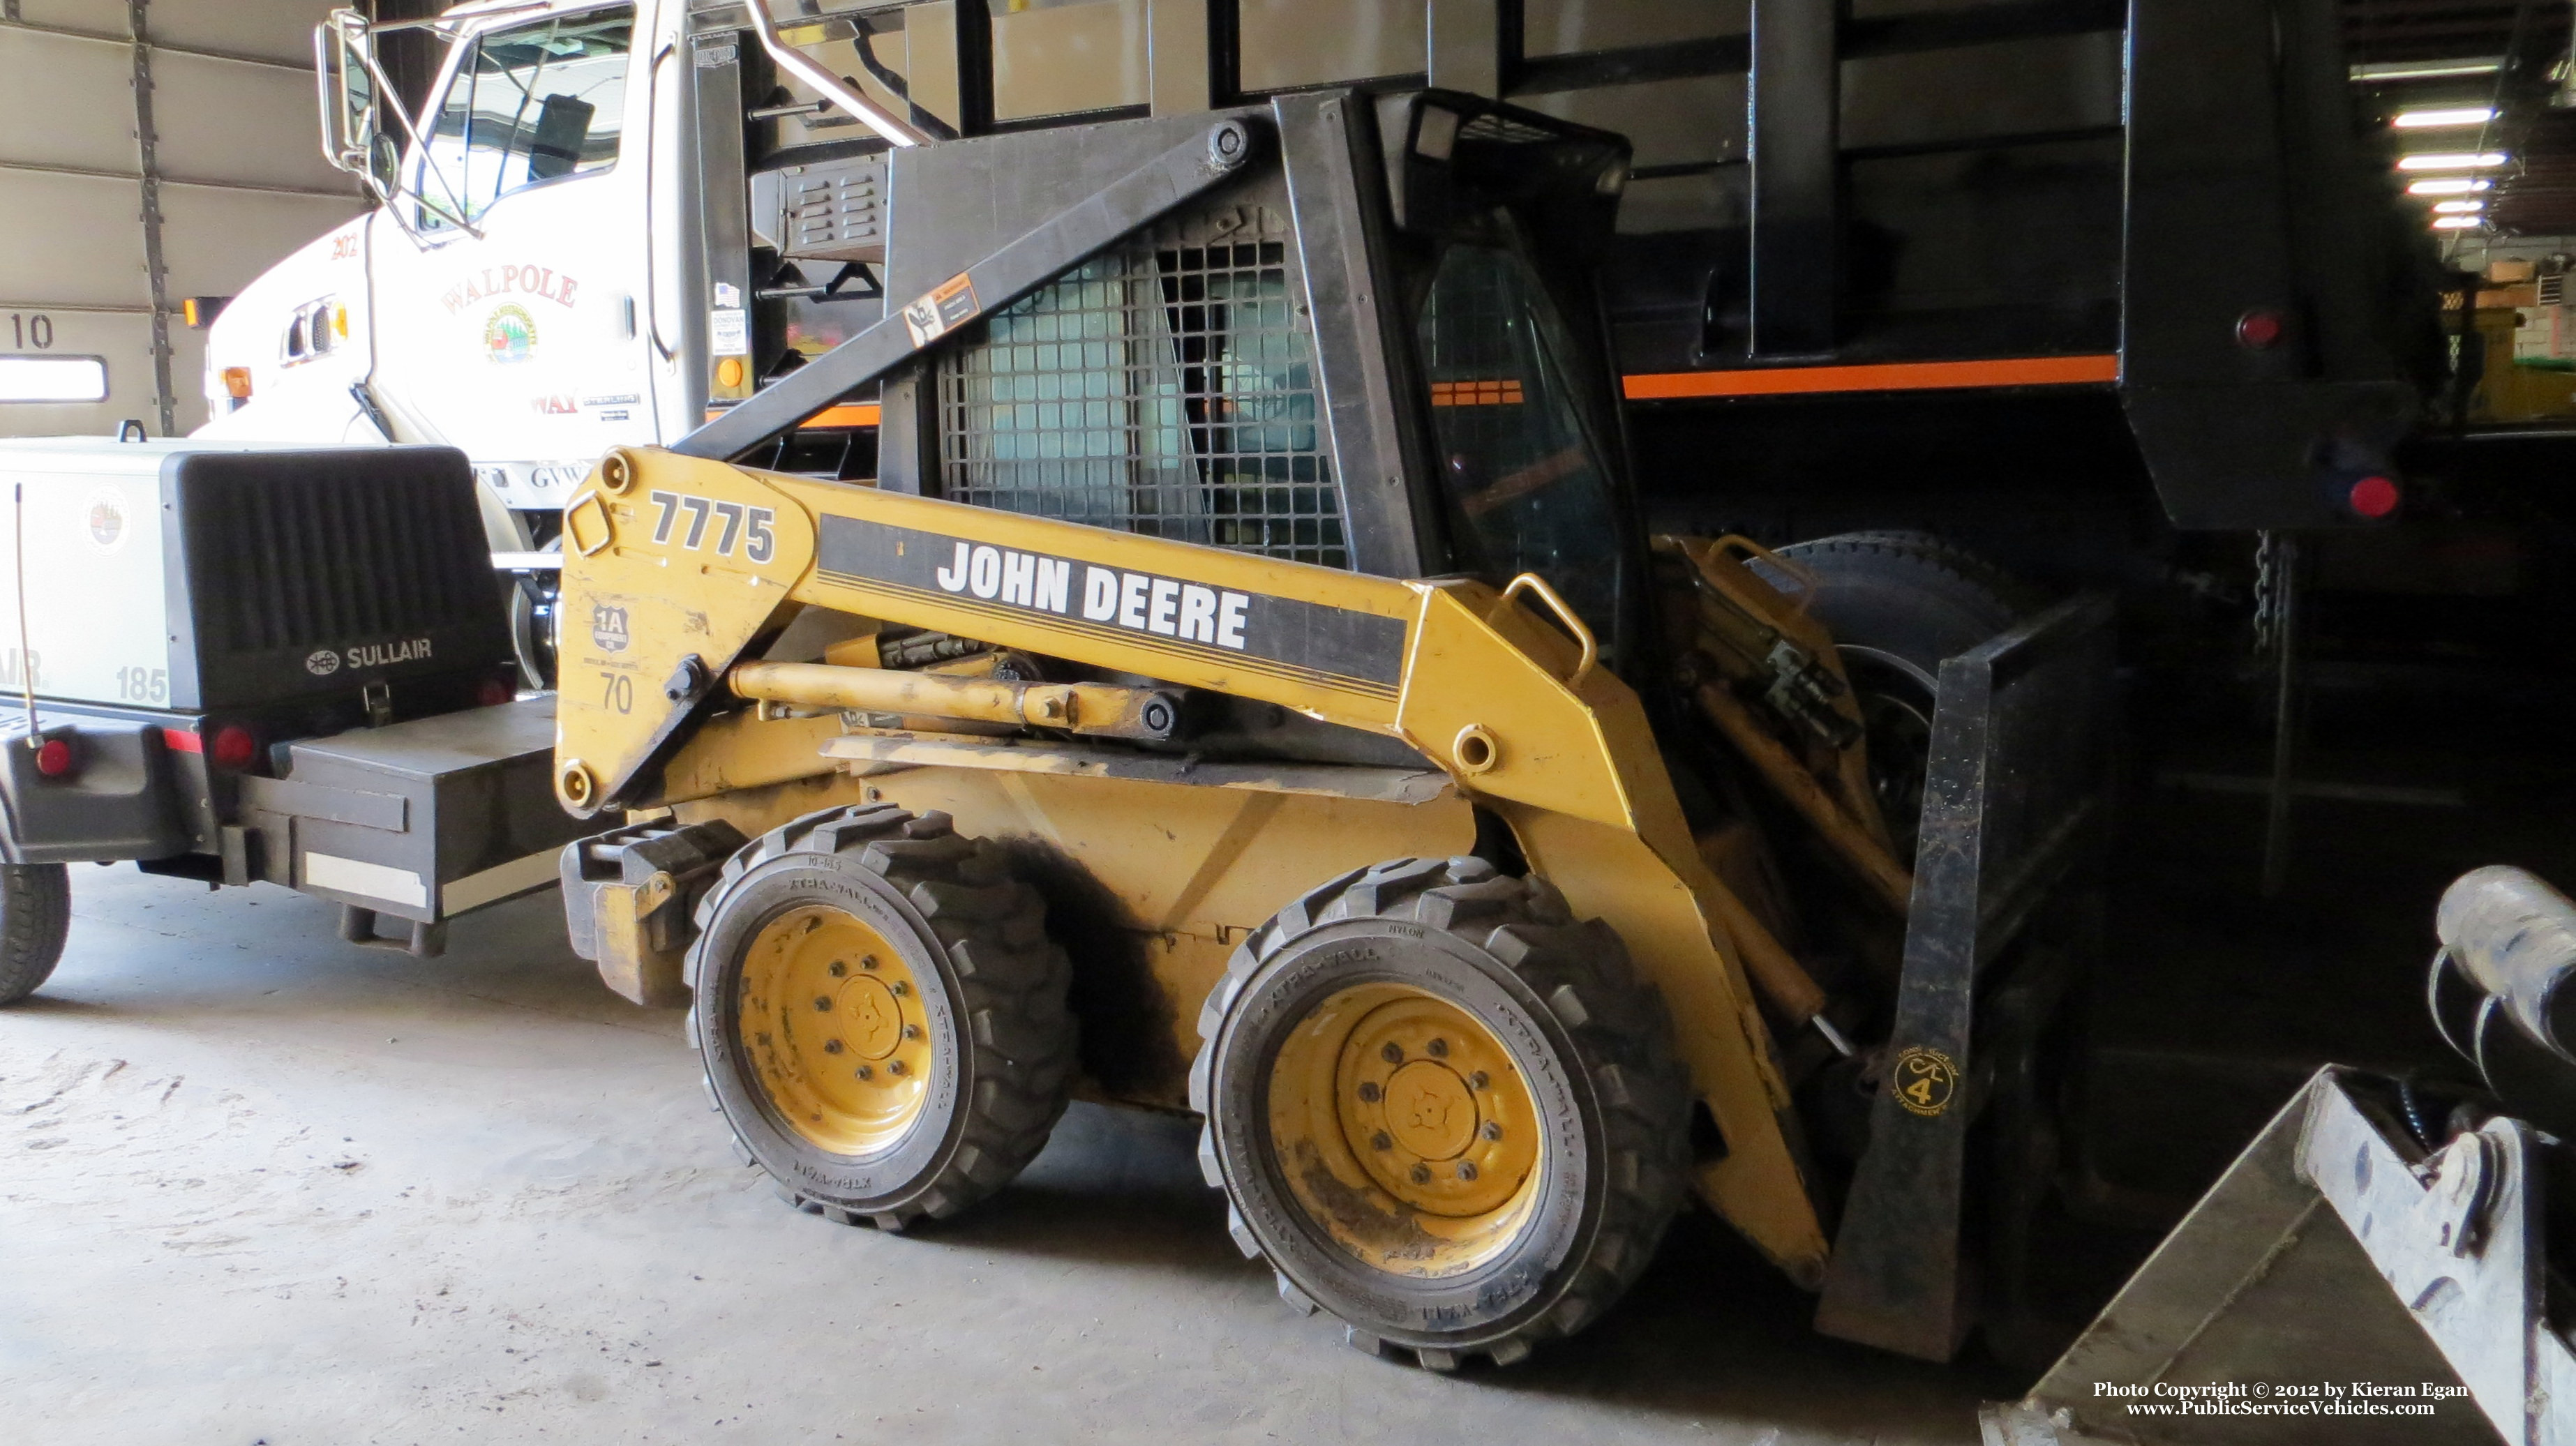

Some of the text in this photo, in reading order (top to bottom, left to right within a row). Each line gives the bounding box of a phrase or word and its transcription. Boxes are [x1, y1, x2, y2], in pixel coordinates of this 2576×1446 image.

[440, 264, 578, 316] WALPOLE
[10, 313, 54, 349] 10
[713, 316, 744, 324] DONOVAN
[585, 394, 636, 405] STERLING
[650, 490, 777, 564] 7775
[938, 542, 1249, 649] JOHN DEERE
[597, 610, 624, 633] 1A
[347, 638, 432, 668] SULLAIR
[117, 666, 166, 702] 185
[600, 672, 633, 714] 70
[1388, 924, 1425, 939] NYLON
[1907, 1078, 1931, 1104] 4
